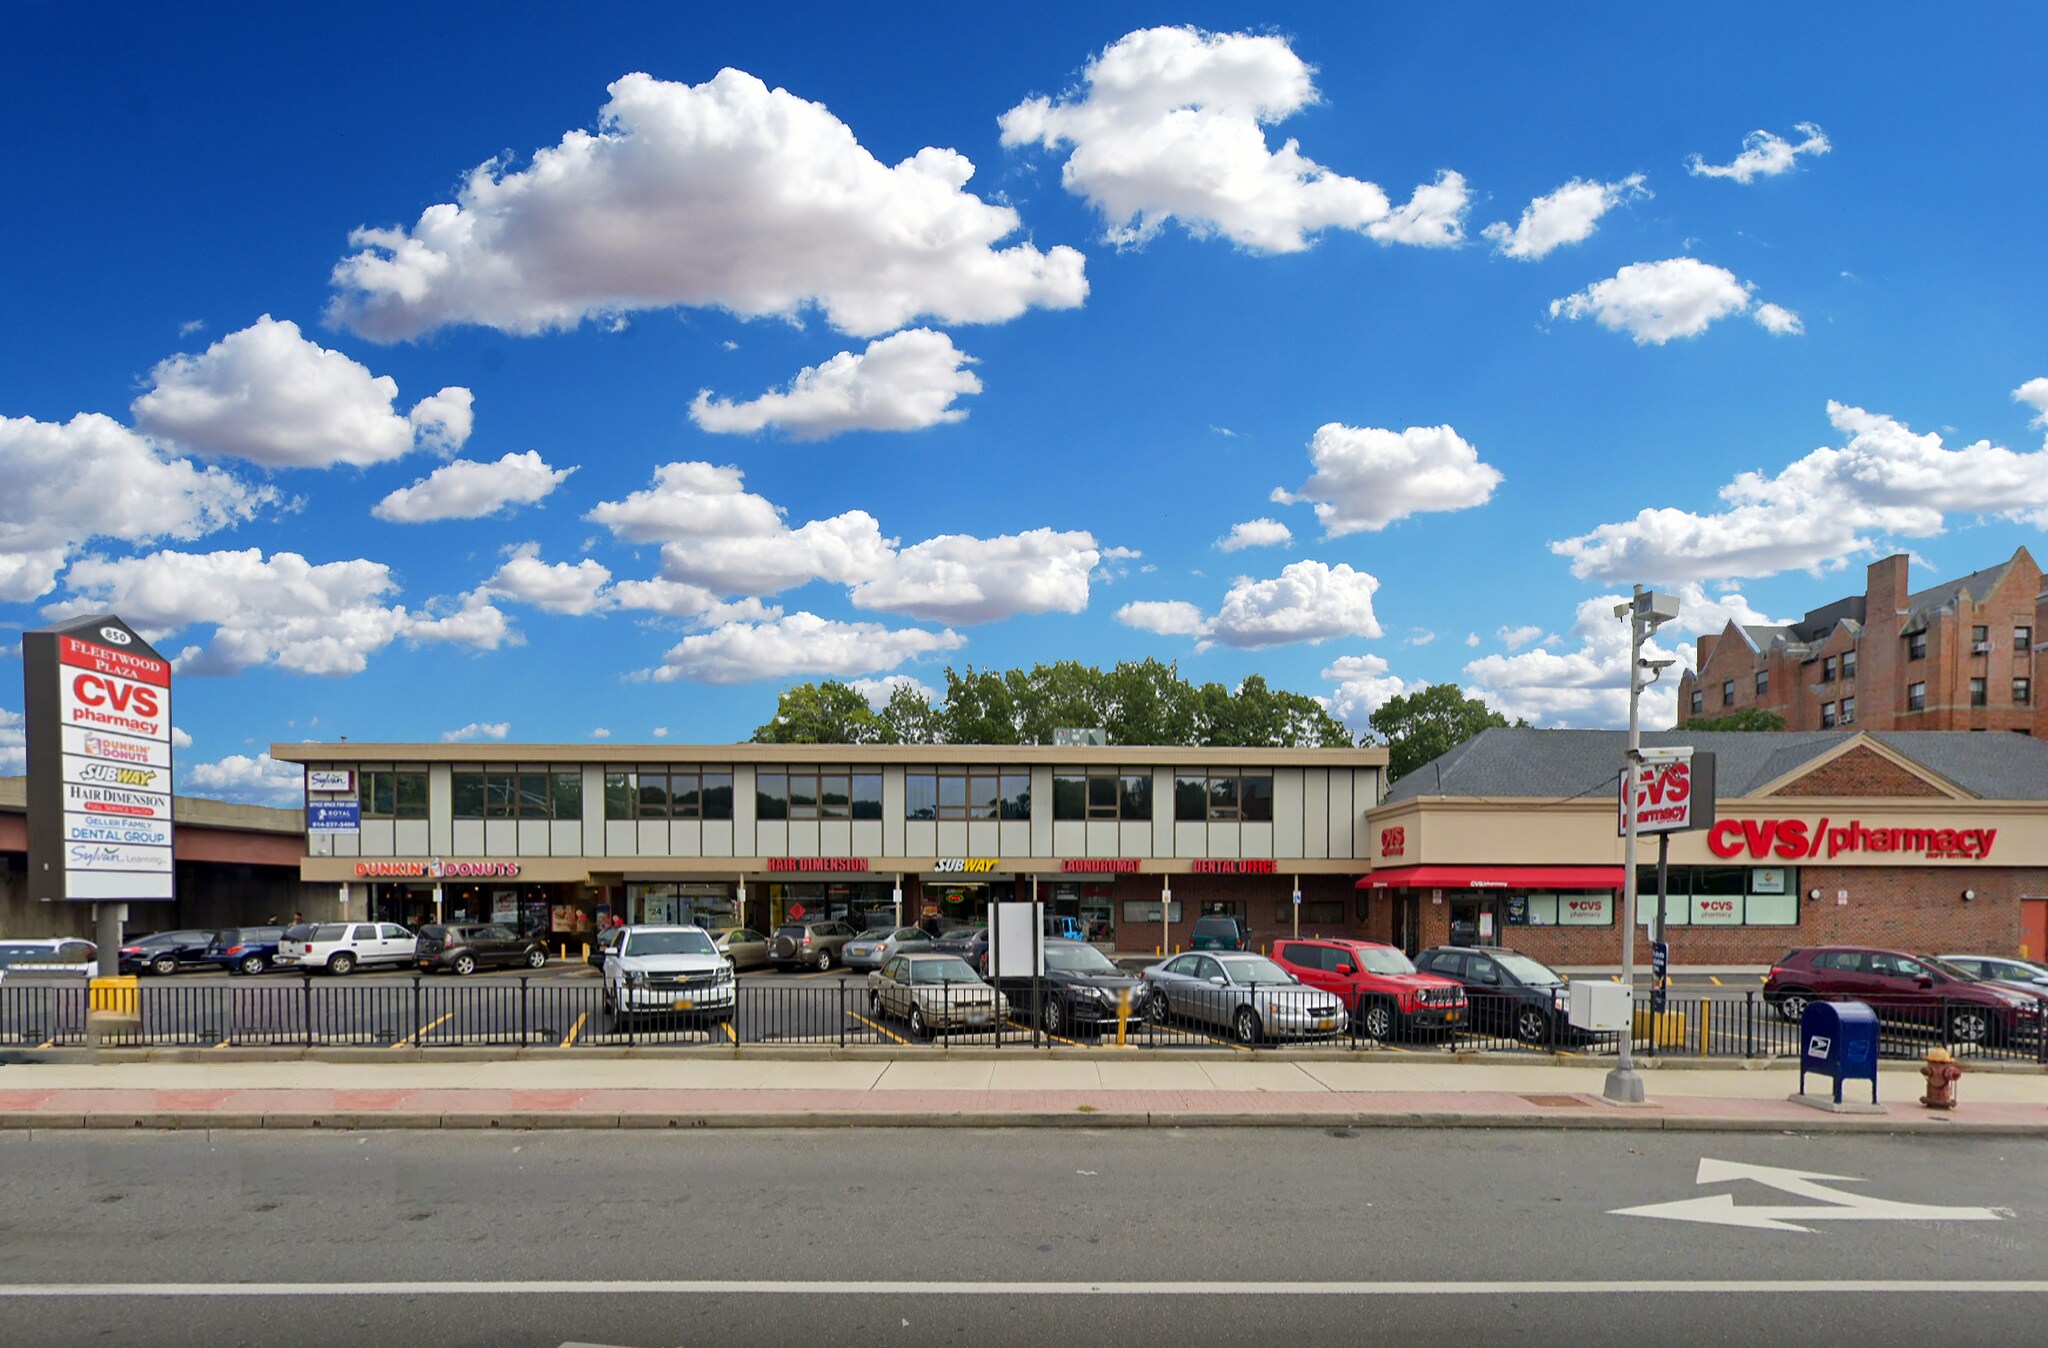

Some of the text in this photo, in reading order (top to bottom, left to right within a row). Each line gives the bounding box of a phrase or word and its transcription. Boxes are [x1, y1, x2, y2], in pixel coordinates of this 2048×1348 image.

[105, 629, 127, 642] 850
[70, 640, 160, 672] FLEETWOOD
[96, 659, 138, 679] PLAZA
[73, 674, 158, 717] CVS
[73, 708, 158, 735] pharmacy
[103, 748, 149, 762] DONUTS
[80, 763, 156, 786] SUBWAY
[71, 786, 165, 807] HAIR DIMENSION
[85, 817, 153, 829] GELLER FAMILY
[71, 828, 165, 842] DENTAL GROUP
[1708, 818, 1997, 859] CVS/pharmacy
[71, 845, 120, 866] Sylvan
[355, 862, 519, 877] DUNKIN' DONUTS
[768, 857, 869, 872] HAIR DIMENSION
[934, 858, 999, 873] SUBWAY
[1062, 858, 1142, 873] LAUNDROMAT
[1193, 859, 1278, 873] DENTAL OFFICE
[1580, 901, 1602, 910] CVS
[1711, 901, 1733, 911] CVS
